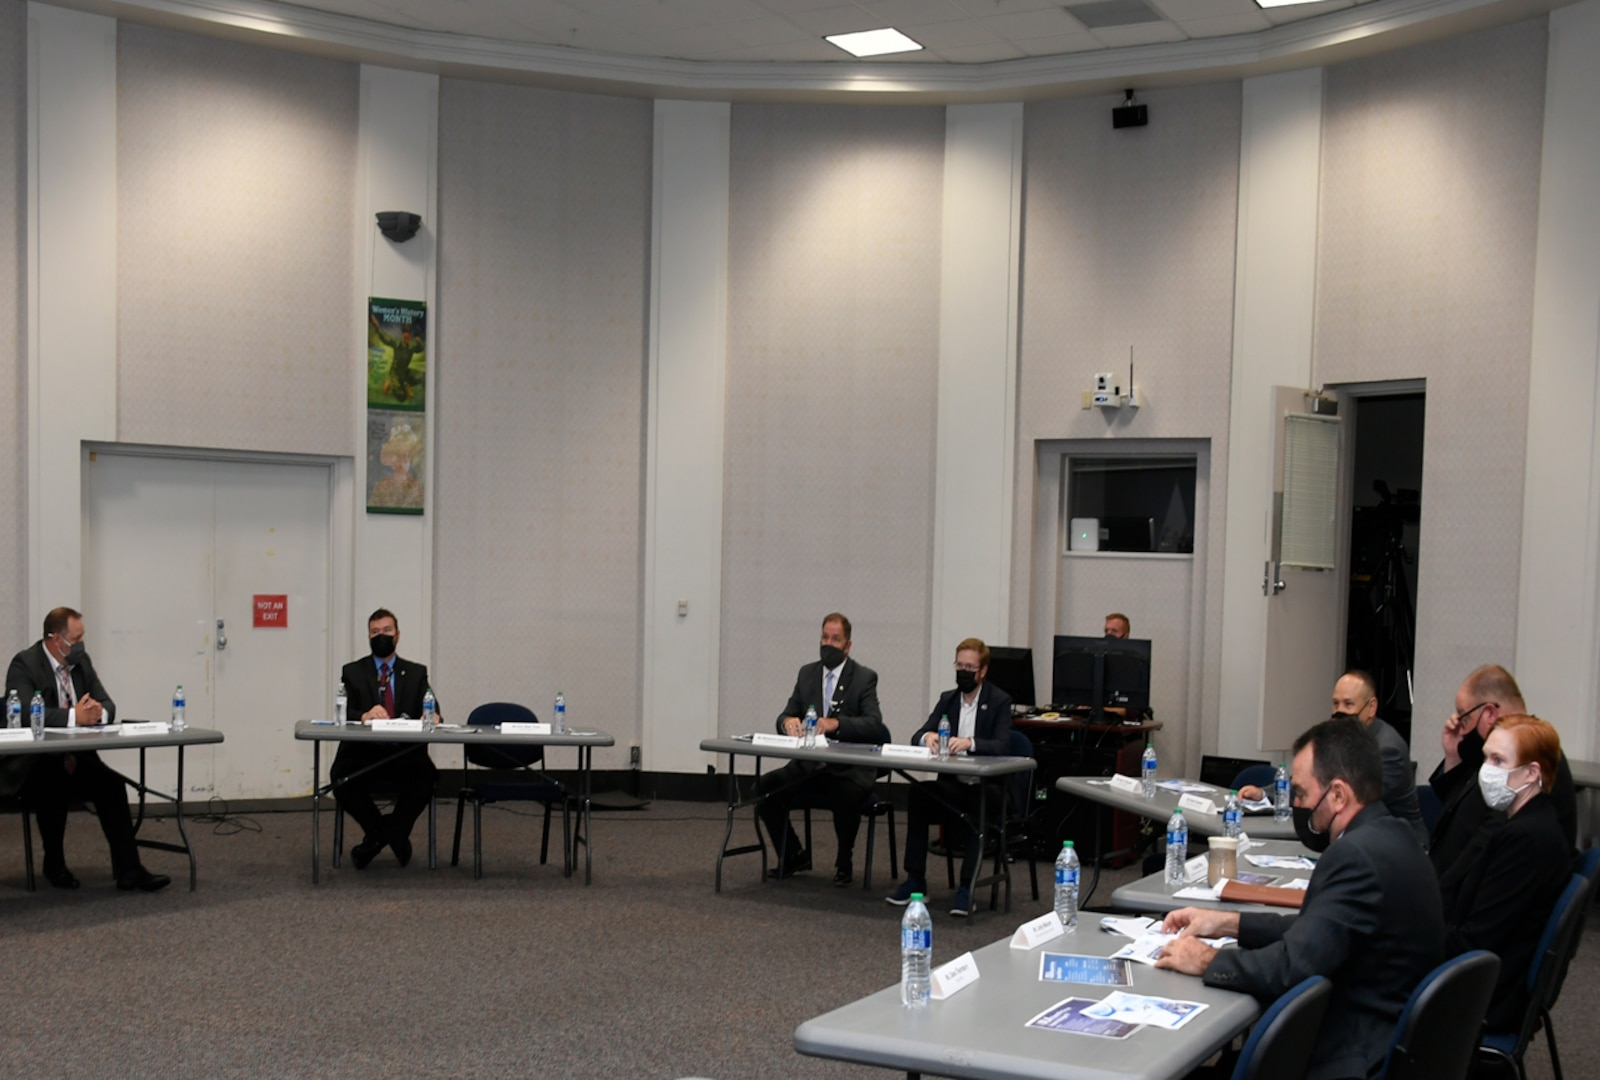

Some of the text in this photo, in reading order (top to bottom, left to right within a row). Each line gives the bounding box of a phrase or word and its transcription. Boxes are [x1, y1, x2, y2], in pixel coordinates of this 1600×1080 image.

[371, 305, 424, 318] Women's History
[383, 313, 412, 324] MONTH
[263, 612, 278, 620] EXIT
